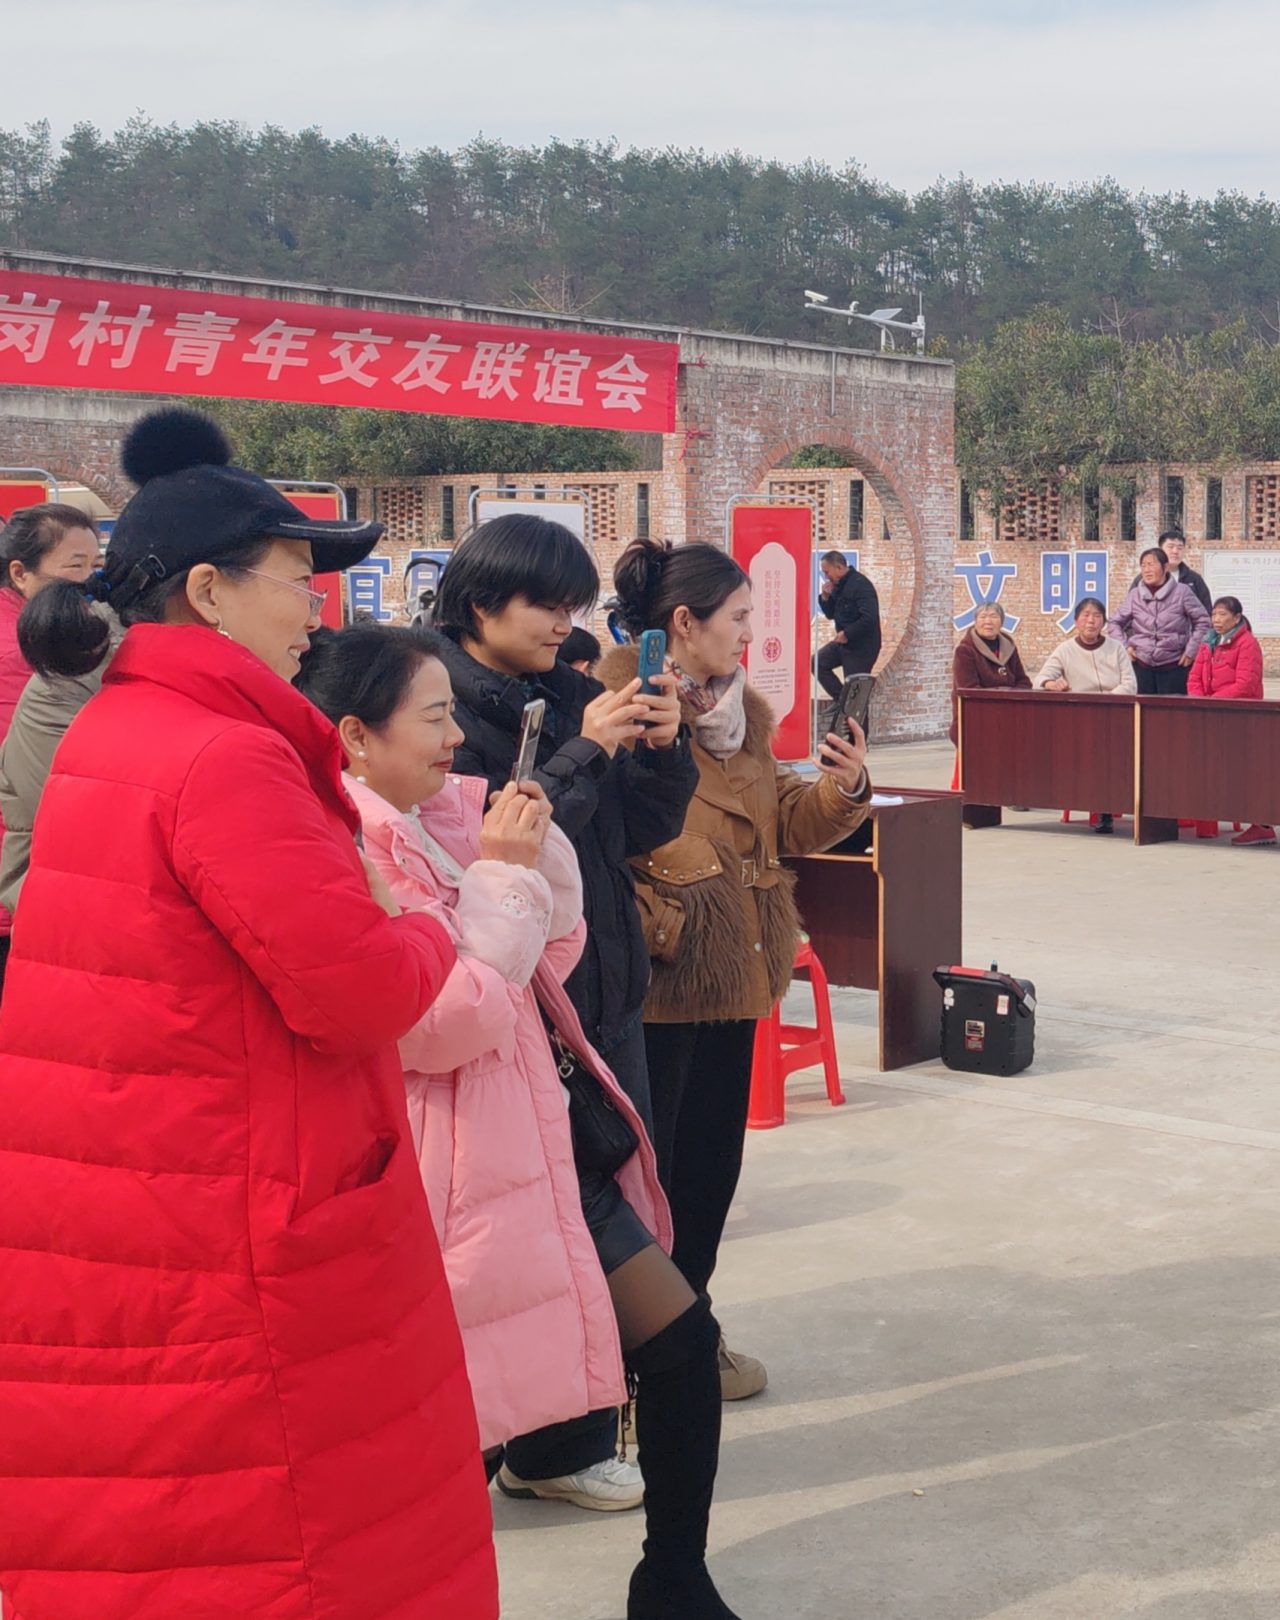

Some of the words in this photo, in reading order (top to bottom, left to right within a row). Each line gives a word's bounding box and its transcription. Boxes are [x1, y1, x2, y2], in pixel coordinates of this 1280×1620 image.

[0, 292, 649, 413] 岗村青年交友联谊会
[953, 550, 1109, 633] 文明
